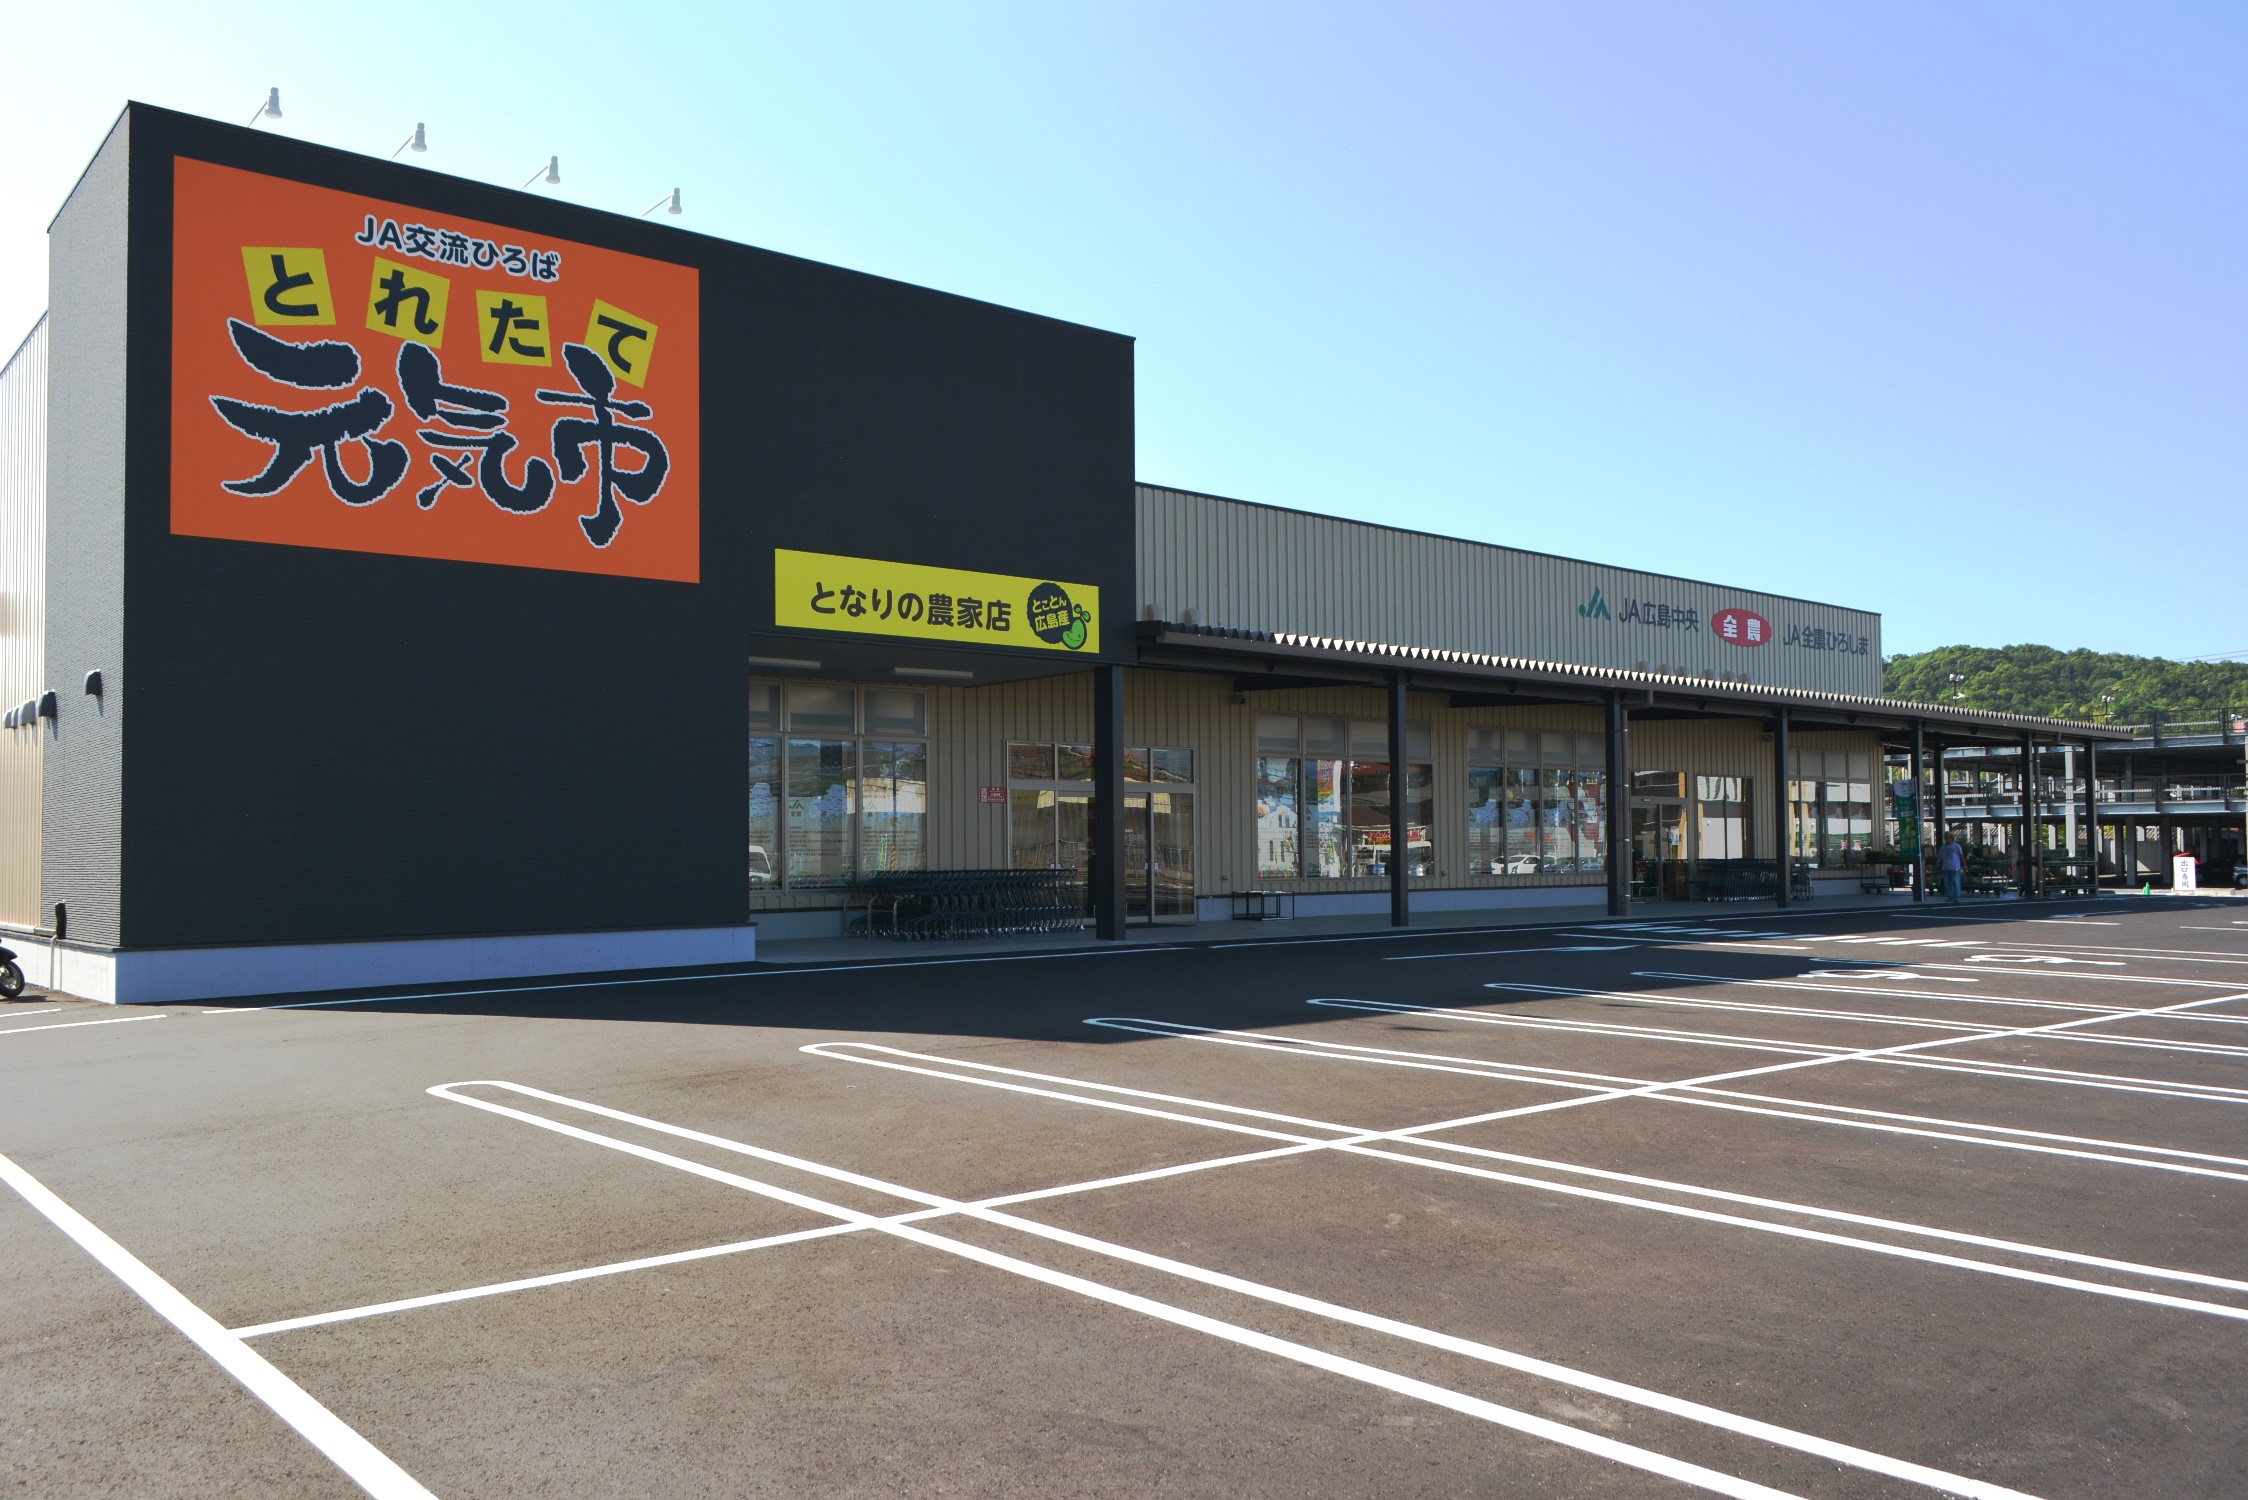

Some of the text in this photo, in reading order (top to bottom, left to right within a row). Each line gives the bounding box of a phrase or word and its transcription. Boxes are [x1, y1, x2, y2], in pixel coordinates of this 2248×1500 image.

[356, 214, 562, 282] JA交流ひろば
[263, 253, 648, 375] とれたて
[209, 317, 671, 548] 元気市
[810, 581, 1012, 632] となりの農家店
[1032, 595, 1067, 613] とことん
[1035, 610, 1071, 632] 広島産
[1619, 597, 1699, 632] JA広島中央
[1722, 614, 1762, 642] 全農
[1783, 623, 1869, 656] JA全農ひろしま
